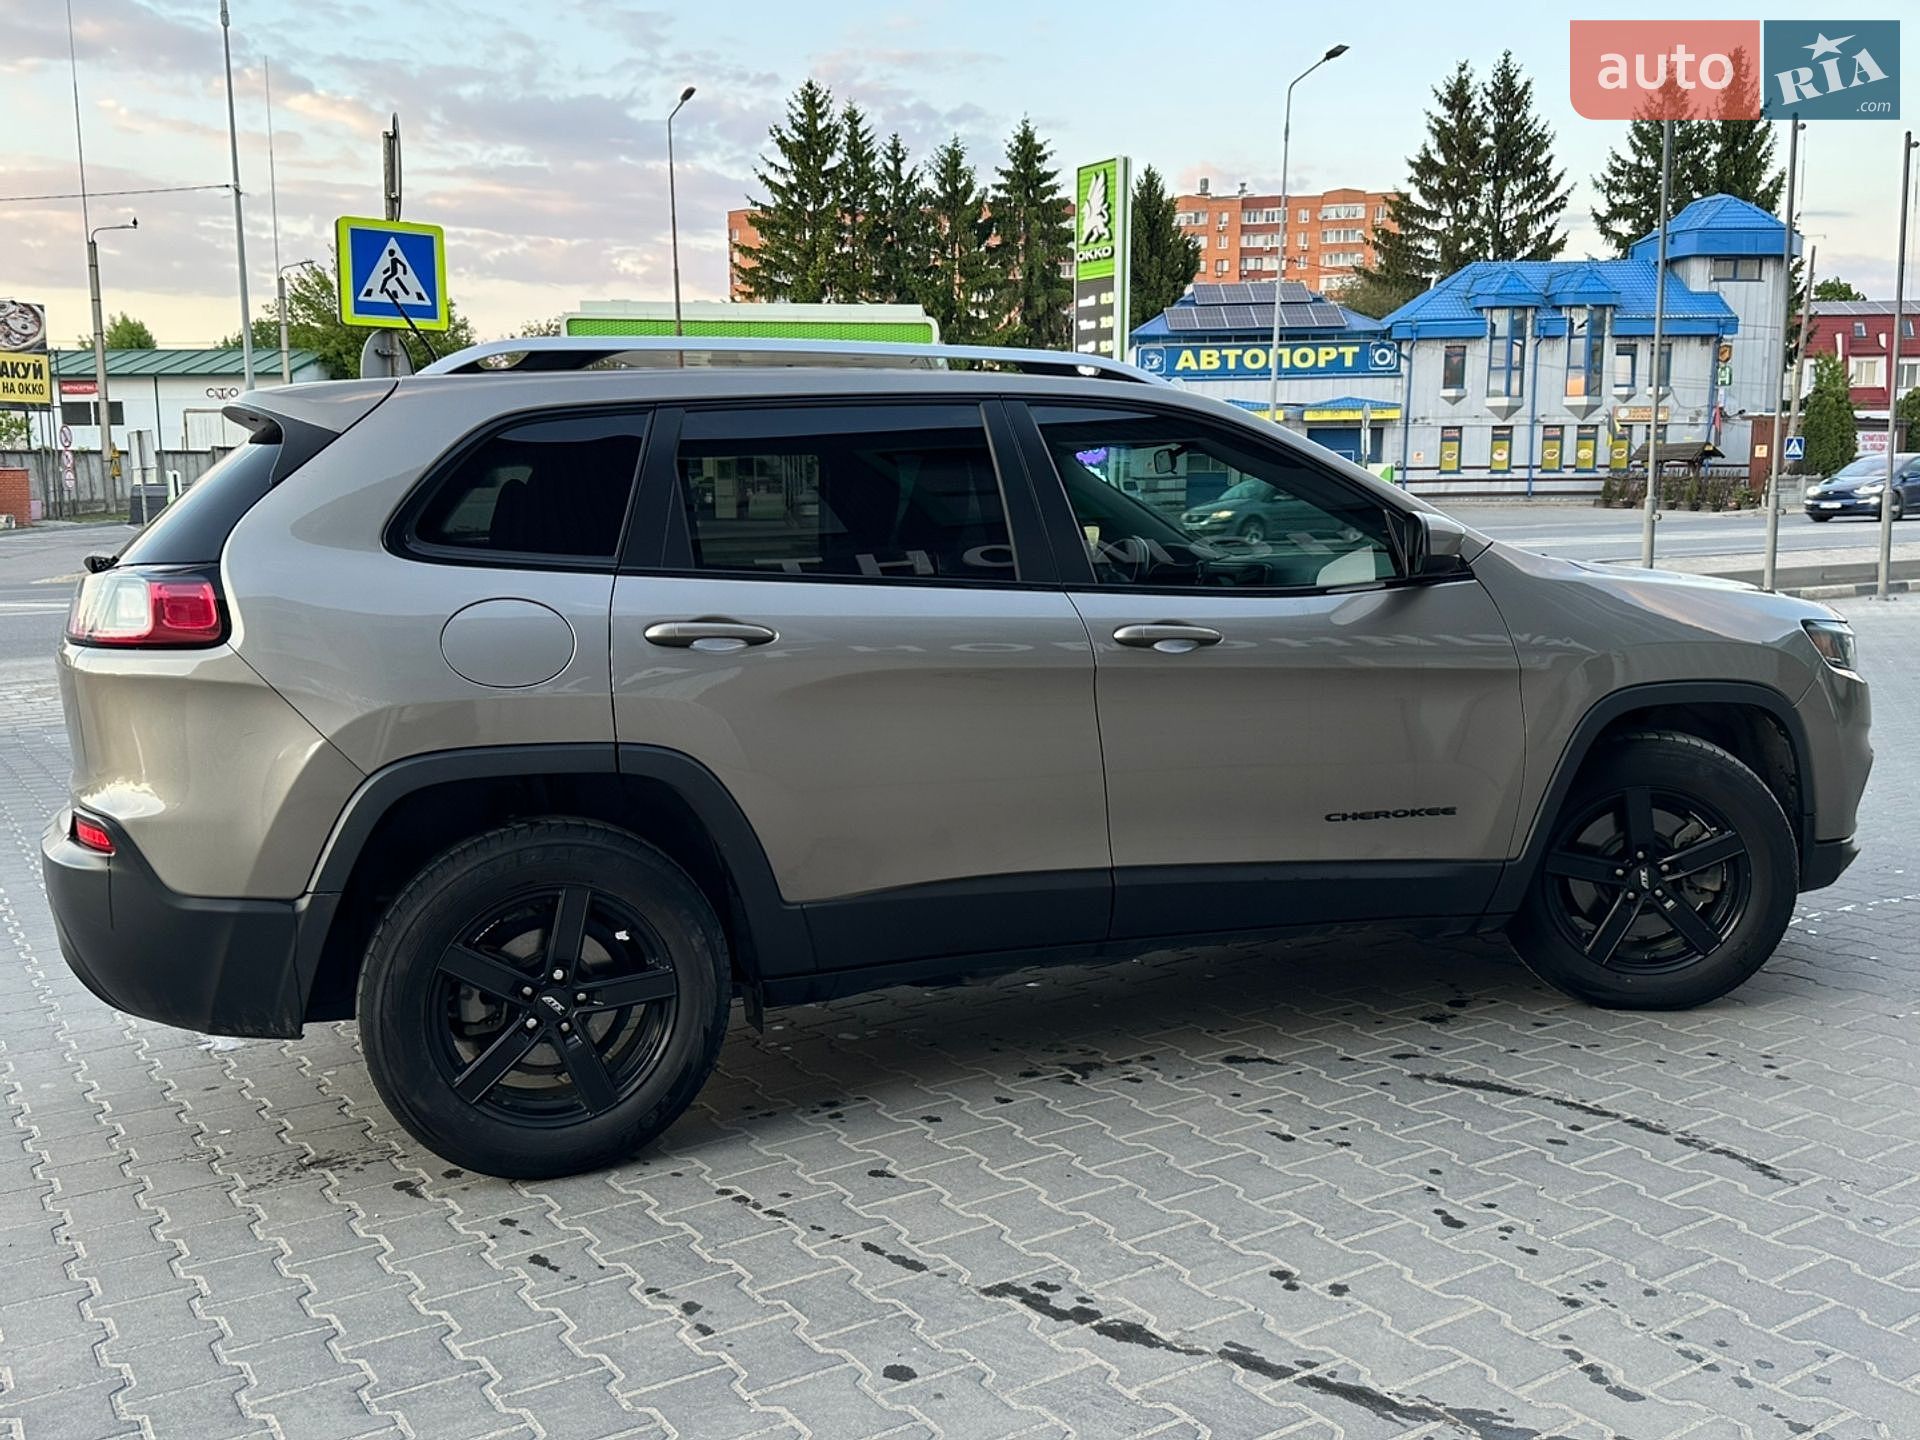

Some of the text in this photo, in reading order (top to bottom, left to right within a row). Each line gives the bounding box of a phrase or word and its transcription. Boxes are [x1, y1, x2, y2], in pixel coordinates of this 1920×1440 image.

[1175, 346, 1360, 371] АВТОПОРТ
[2, 382, 16, 394] НА
[1325, 806, 1457, 822] CHEROKEE
